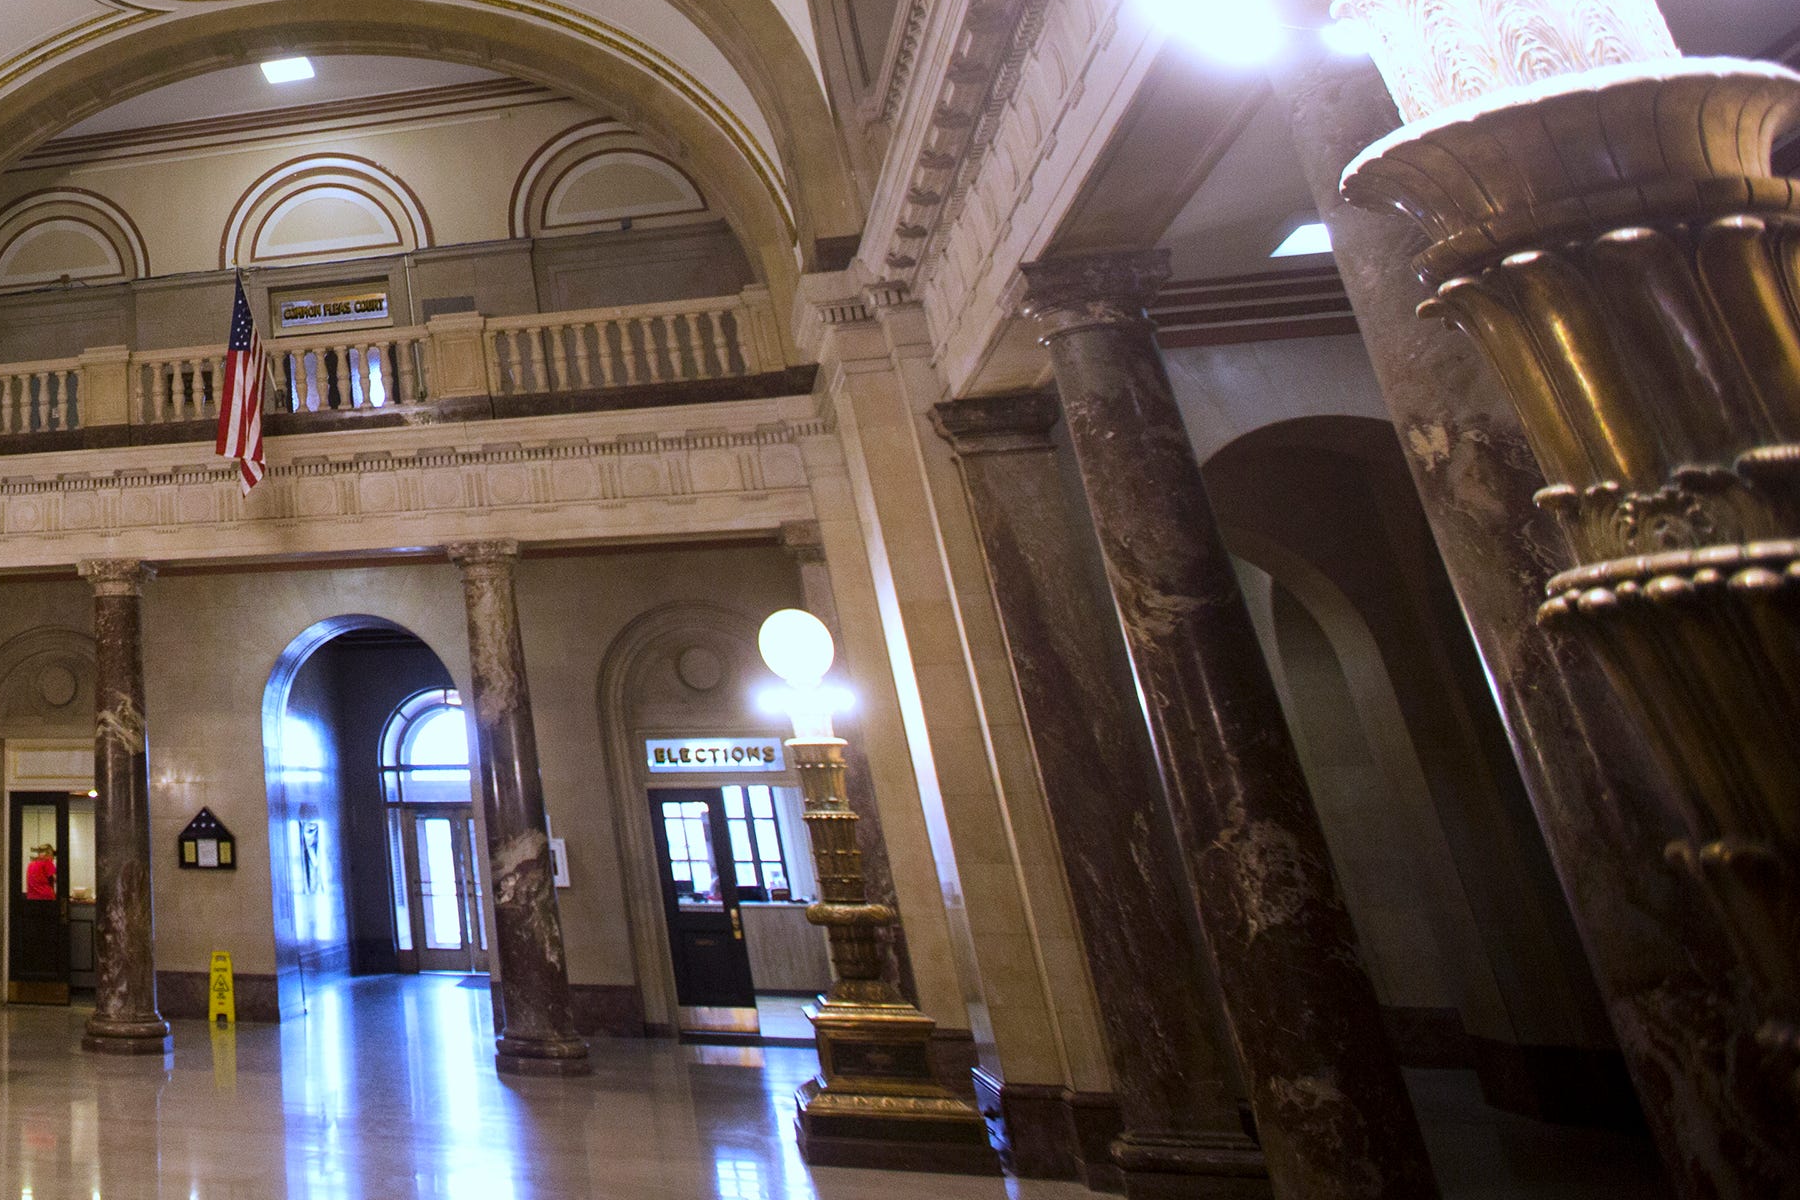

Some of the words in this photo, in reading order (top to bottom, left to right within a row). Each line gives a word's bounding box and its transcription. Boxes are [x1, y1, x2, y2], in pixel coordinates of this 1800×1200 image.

[283, 303, 321, 320] COMMON
[323, 301, 351, 317] PLEAS
[354, 298, 384, 312] COURT
[653, 746, 776, 764] ELECTIONS
